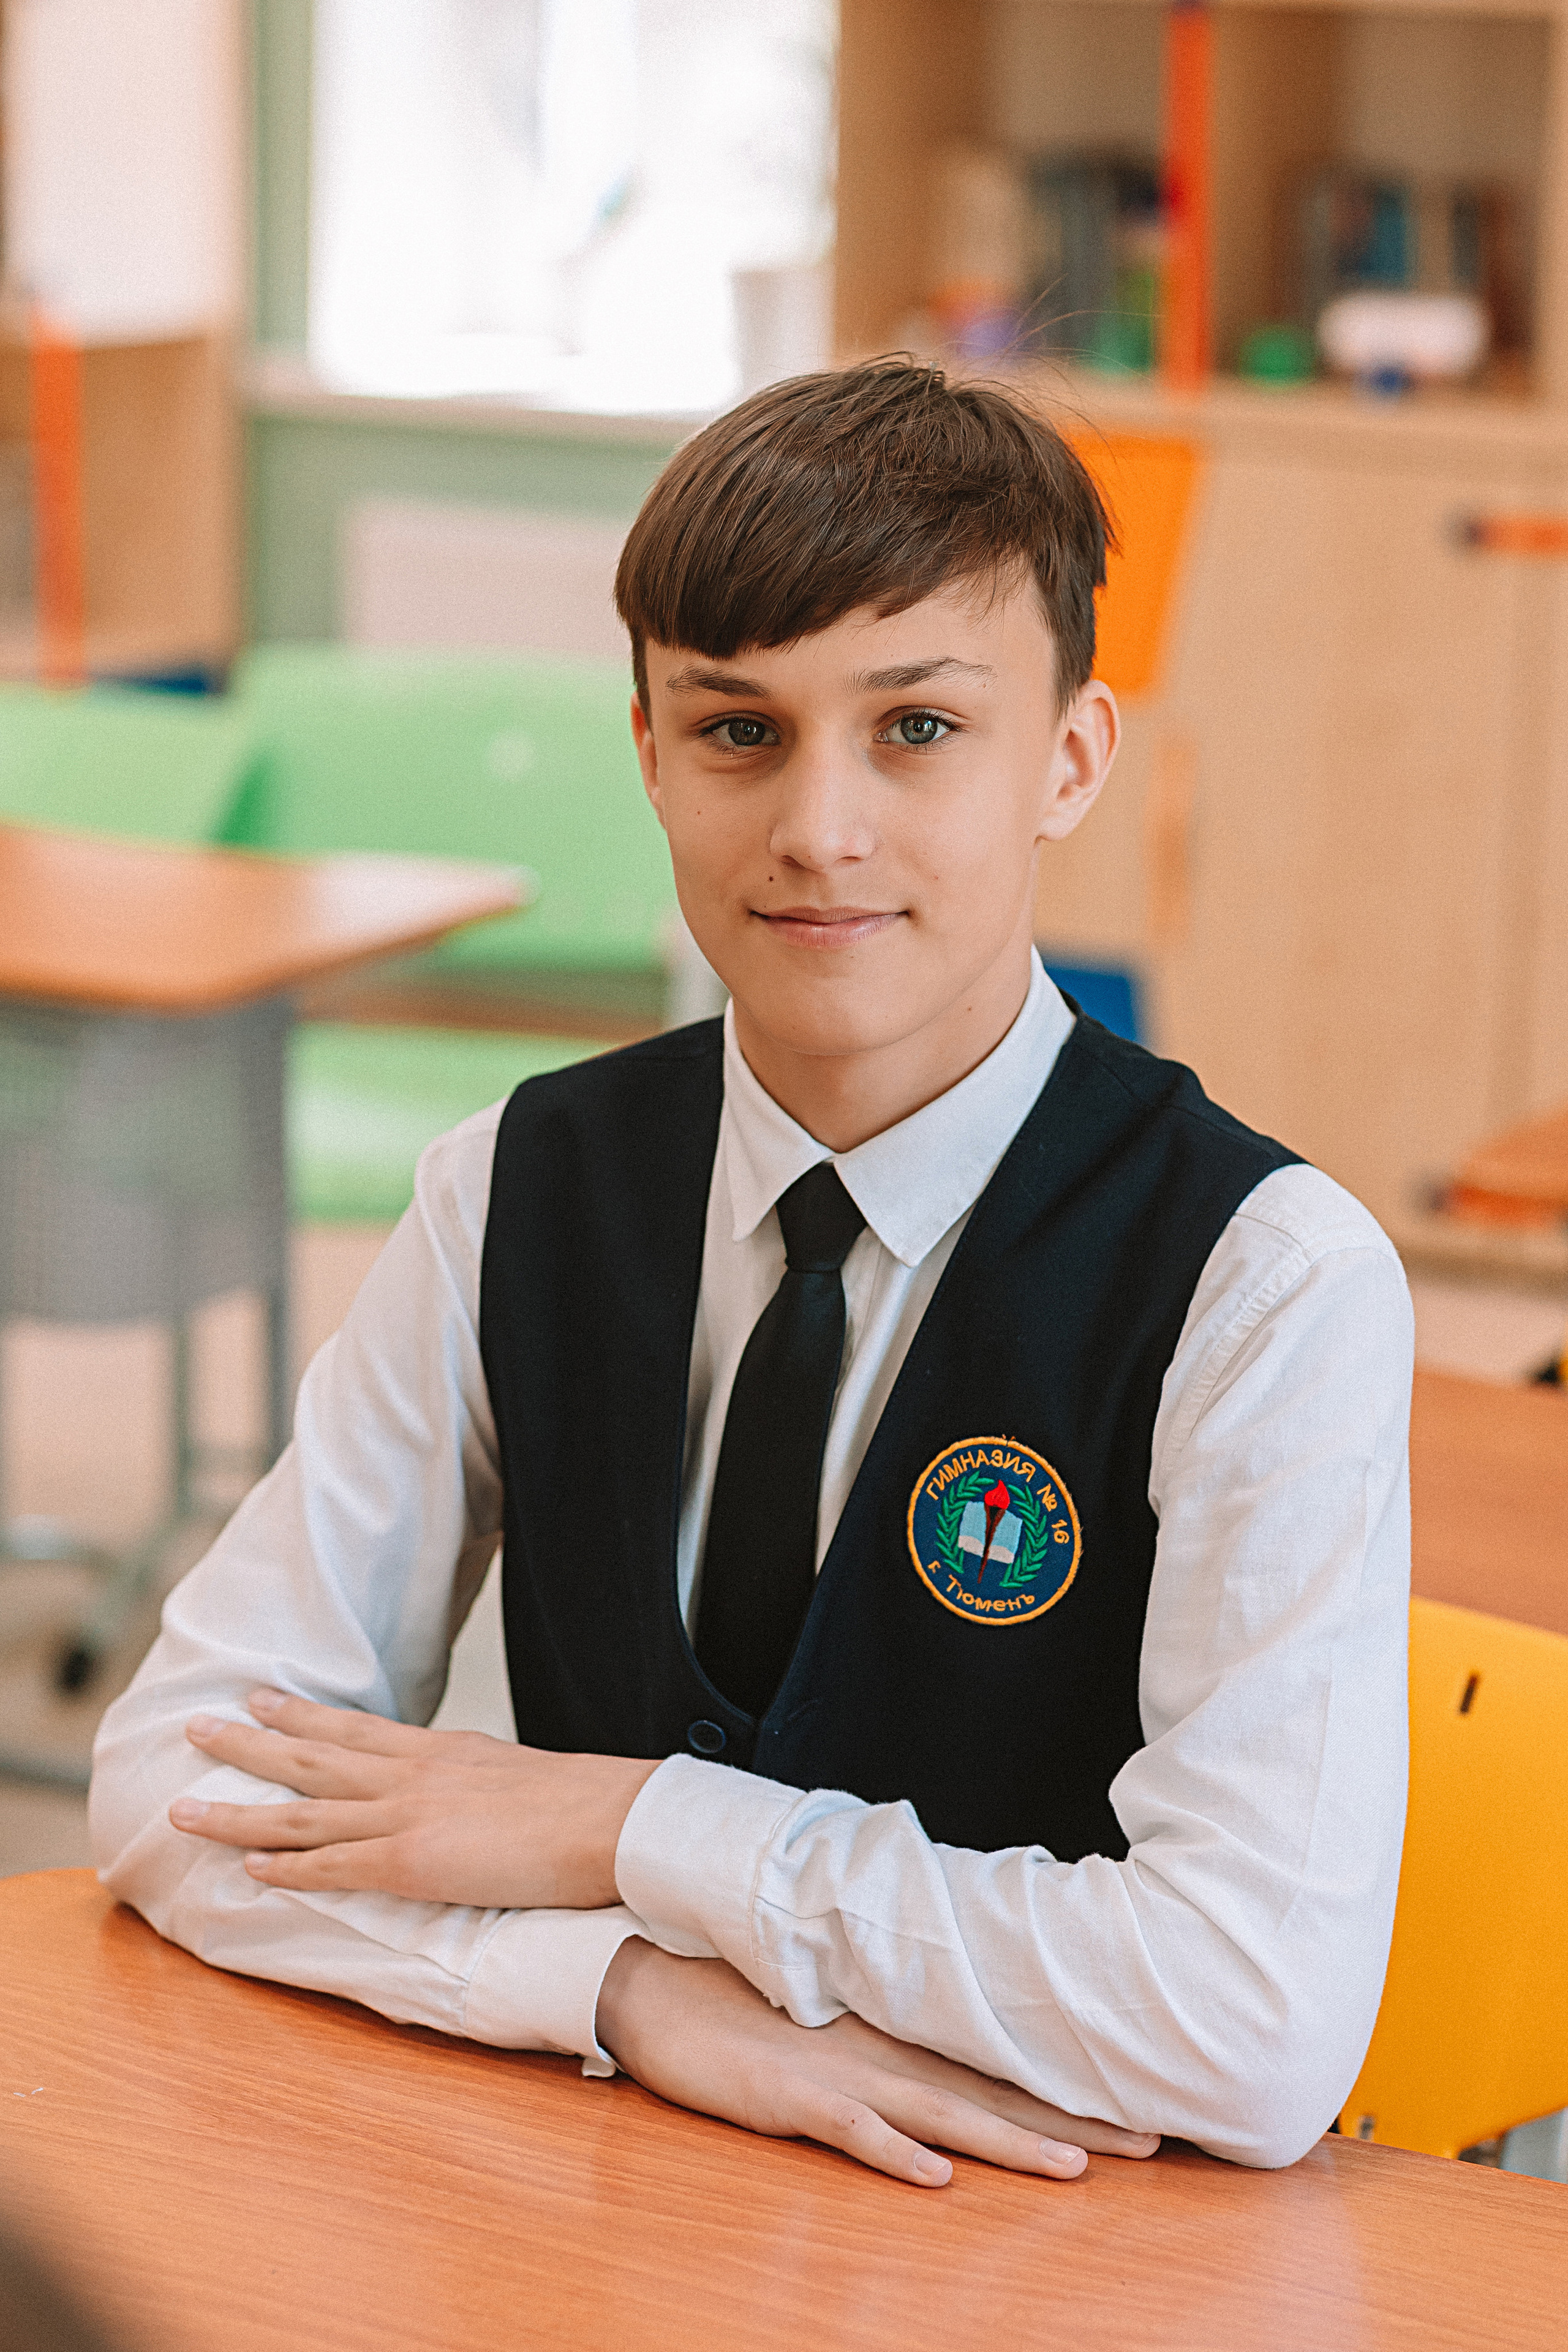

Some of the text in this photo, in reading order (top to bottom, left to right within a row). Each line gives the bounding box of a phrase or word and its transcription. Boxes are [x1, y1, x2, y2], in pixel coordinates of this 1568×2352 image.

[926, 1449, 1069, 1544] ГИМНАЗИЯ № 16
